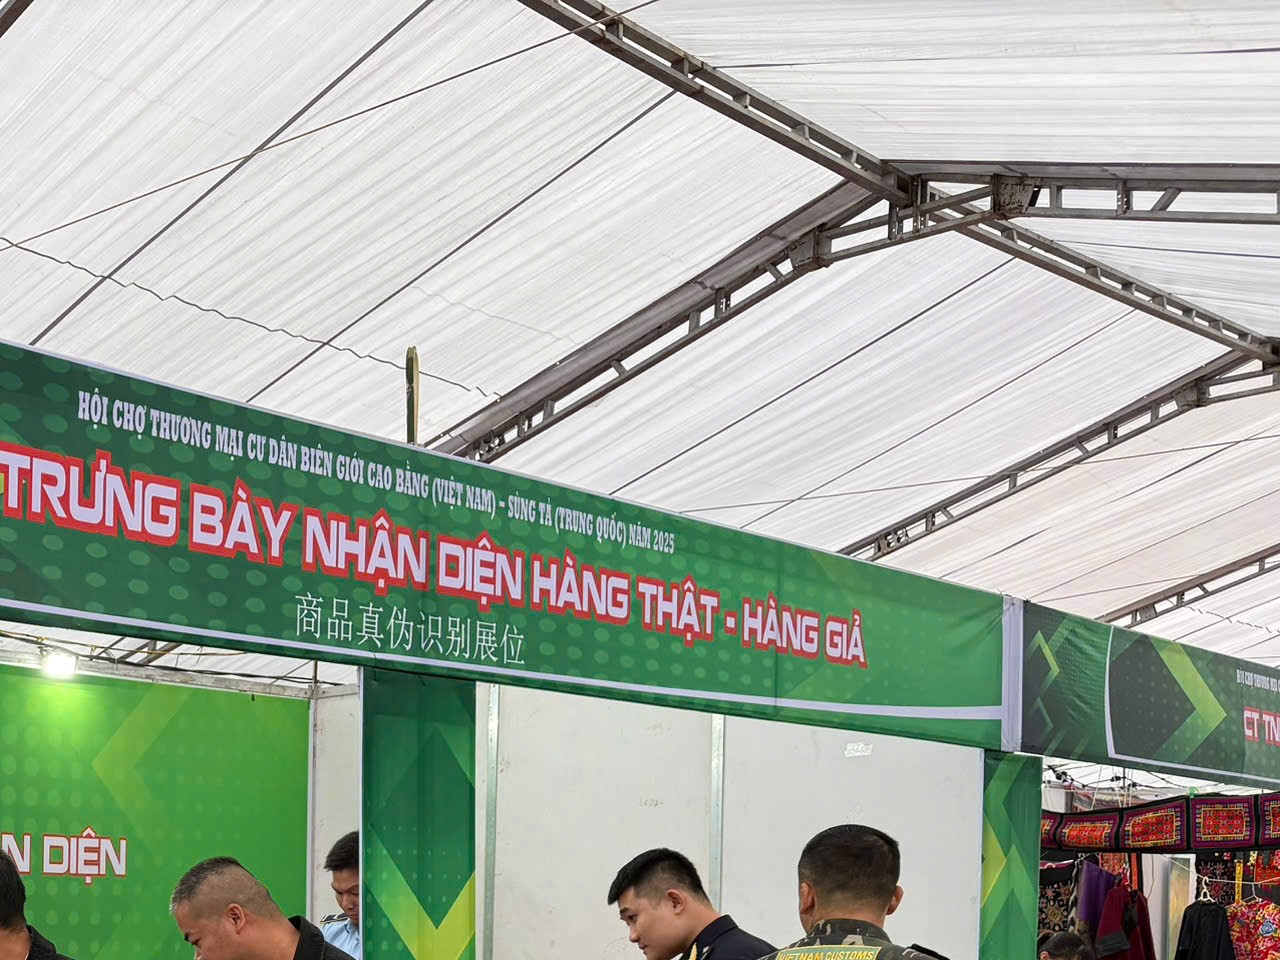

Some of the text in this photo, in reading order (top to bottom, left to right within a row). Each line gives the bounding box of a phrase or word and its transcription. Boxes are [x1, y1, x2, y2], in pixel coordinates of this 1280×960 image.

[78, 387, 109, 430] HỘI
[112, 399, 147, 440] CHỢ
[150, 408, 212, 449] THƯƠNG
[215, 424, 244, 461] MẠI
[247, 432, 267, 462] CƯ
[268, 435, 298, 470] DÂN
[300, 443, 333, 478] BIÊN
[336, 451, 365, 484] GIỚI
[368, 462, 392, 490] CAO
[395, 460, 429, 498] BẰNG
[432, 475, 463, 510] (VIỆT
[466, 485, 496, 520] NAM)
[508, 491, 536, 525] SÙNG
[554, 506, 594, 535] (TRUNG
[596, 512, 627, 549] QUỐC)
[653, 529, 675, 554] 2025
[192, 487, 292, 556] BÀY
[303, 514, 427, 588] NHẬN
[438, 540, 523, 606] DIỆN
[532, 555, 630, 619] HÀNG
[637, 580, 718, 641] THẬT
[742, 598, 820, 653] HÀNG
[824, 613, 866, 663] GIẢ
[294, 591, 526, 665] 商品真伪识别展位
[43, 825, 127, 885] DIỆN
